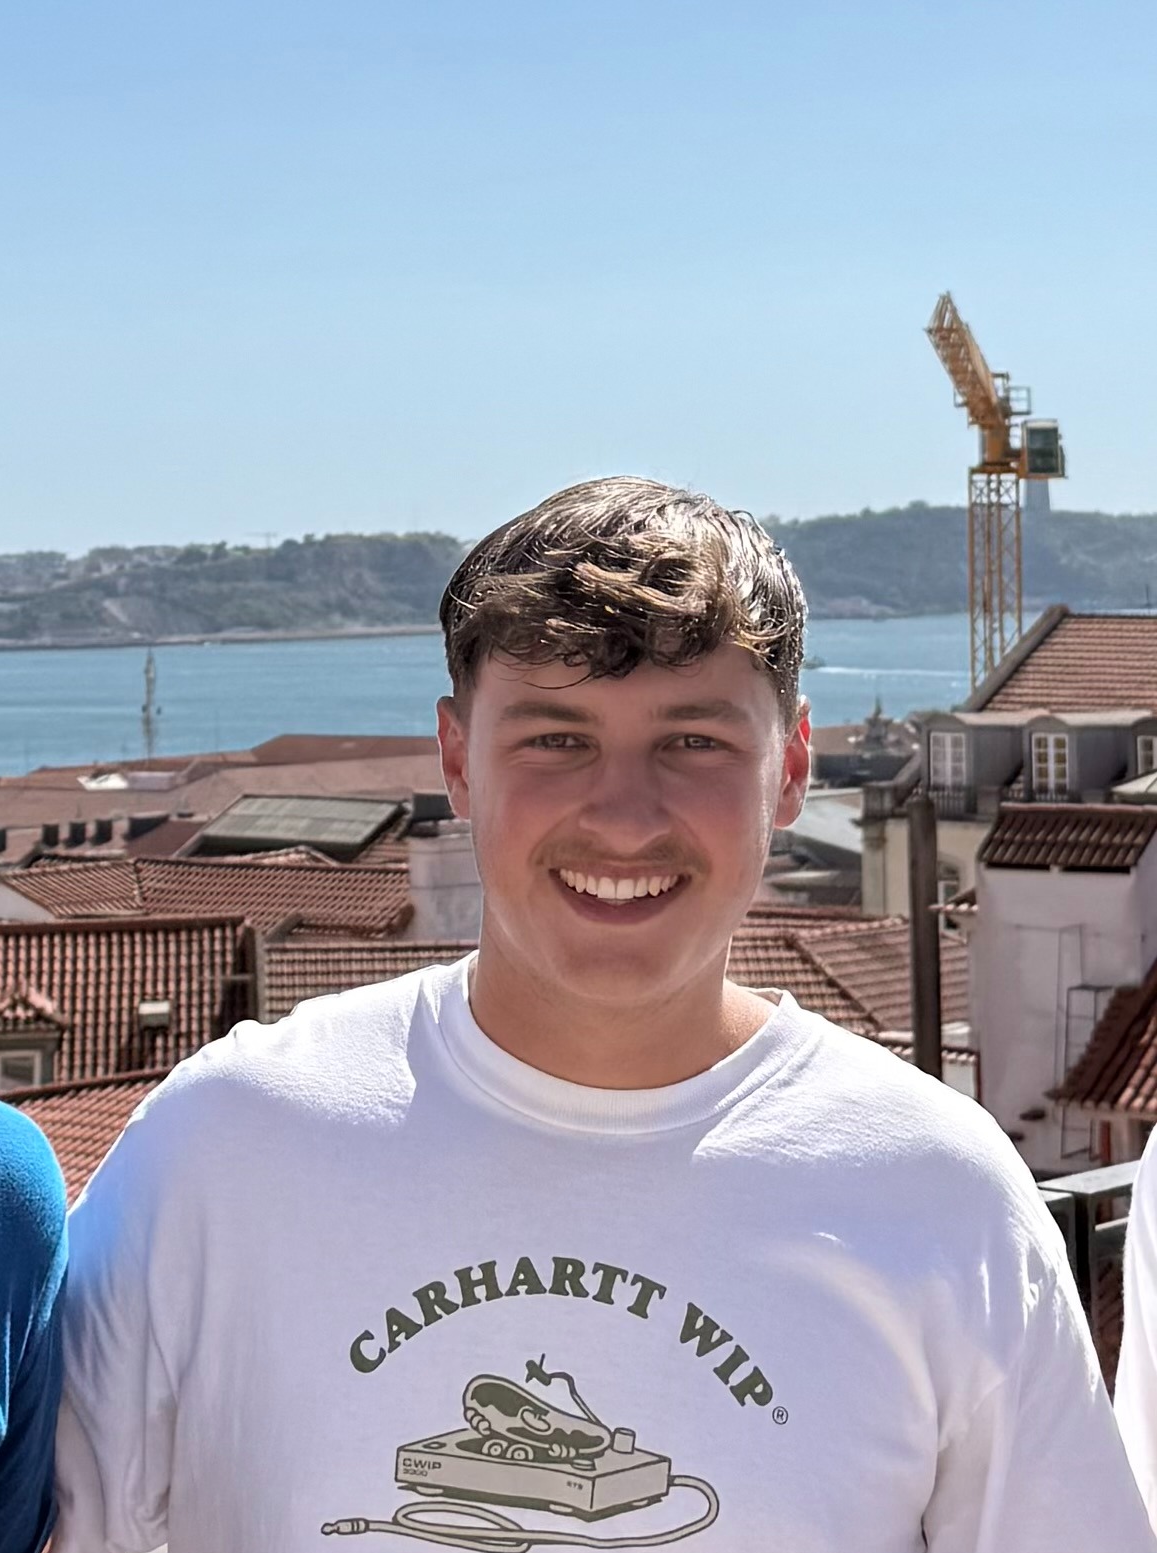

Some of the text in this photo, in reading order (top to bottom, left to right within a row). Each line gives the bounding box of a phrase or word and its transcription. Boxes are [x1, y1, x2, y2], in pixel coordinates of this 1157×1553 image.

[350, 1257, 774, 1406] CARHARTT WIP
[402, 1458, 442, 1470] CWIP
